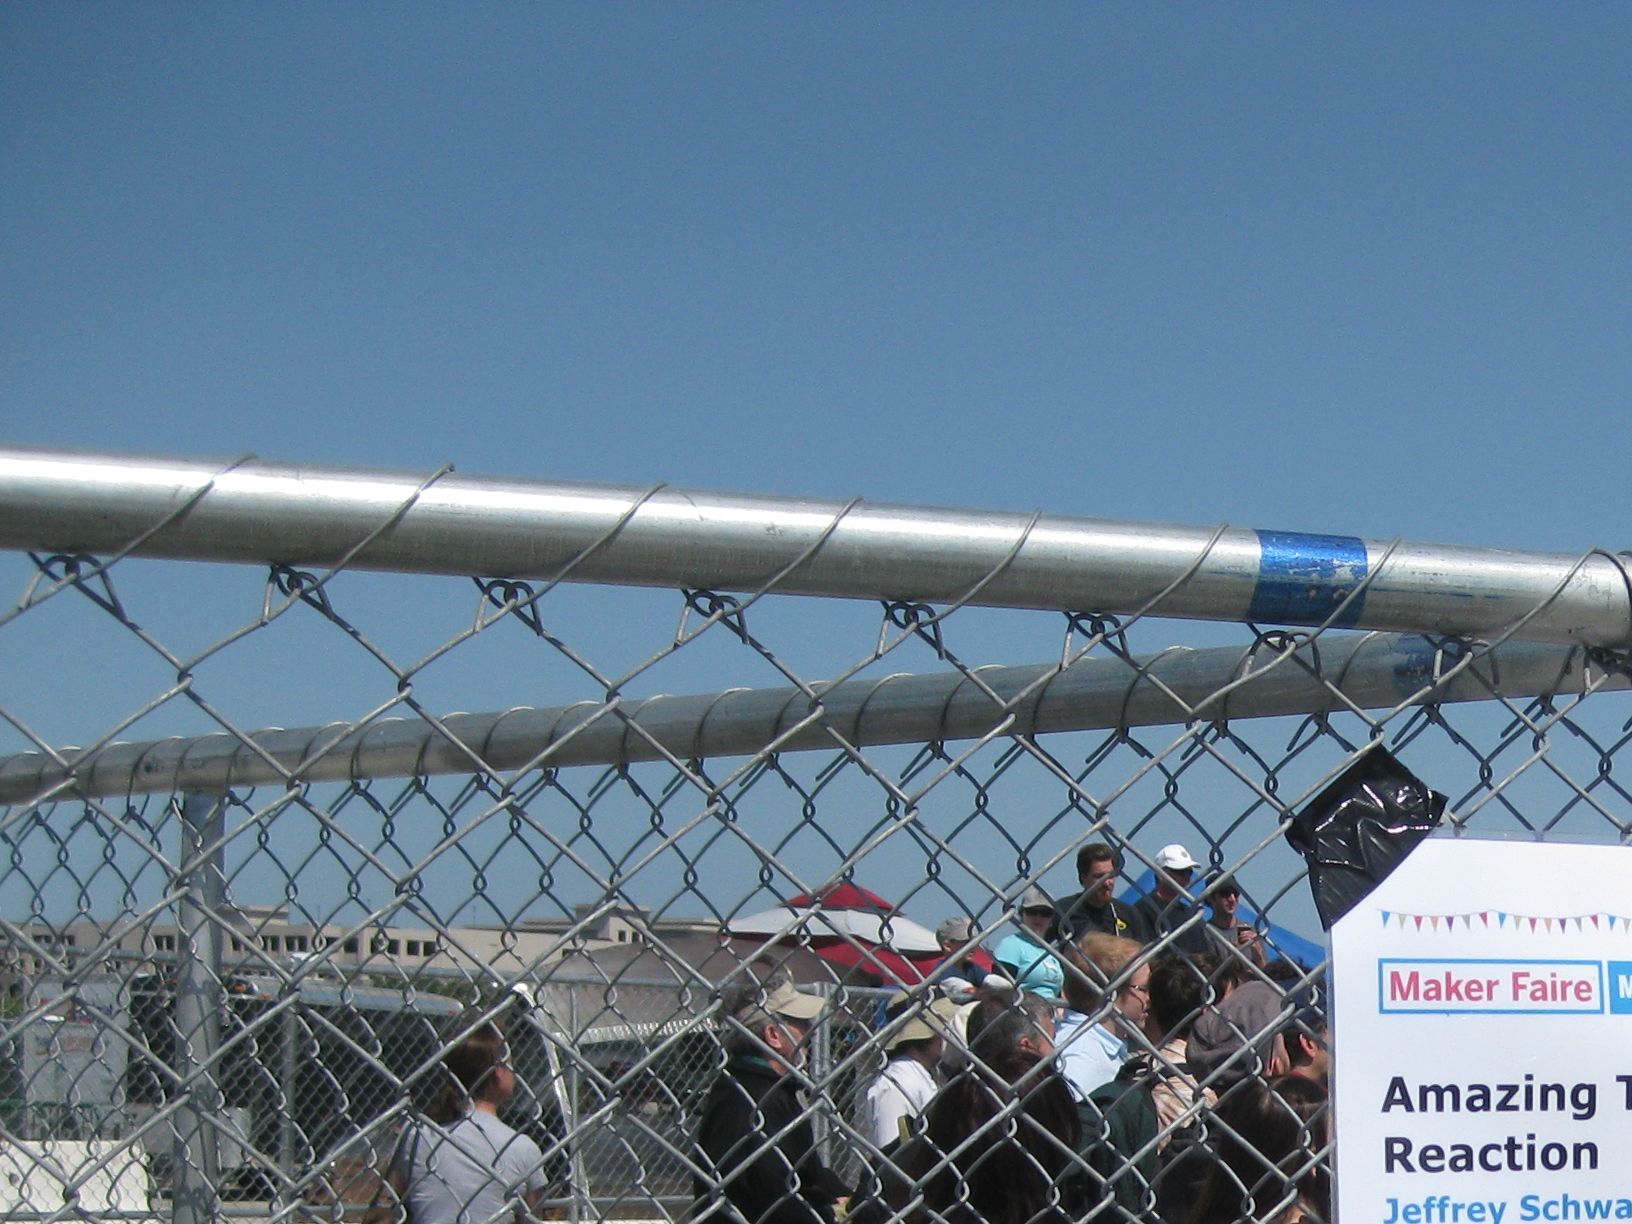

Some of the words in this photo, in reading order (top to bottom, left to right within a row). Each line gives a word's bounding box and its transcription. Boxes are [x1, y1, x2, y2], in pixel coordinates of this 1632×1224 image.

[1390, 971, 1499, 1001] Maker
[1512, 972, 1592, 1002] Faire
[1382, 1074, 1596, 1120] Amazing
[1385, 1133, 1598, 1173] Reaction
